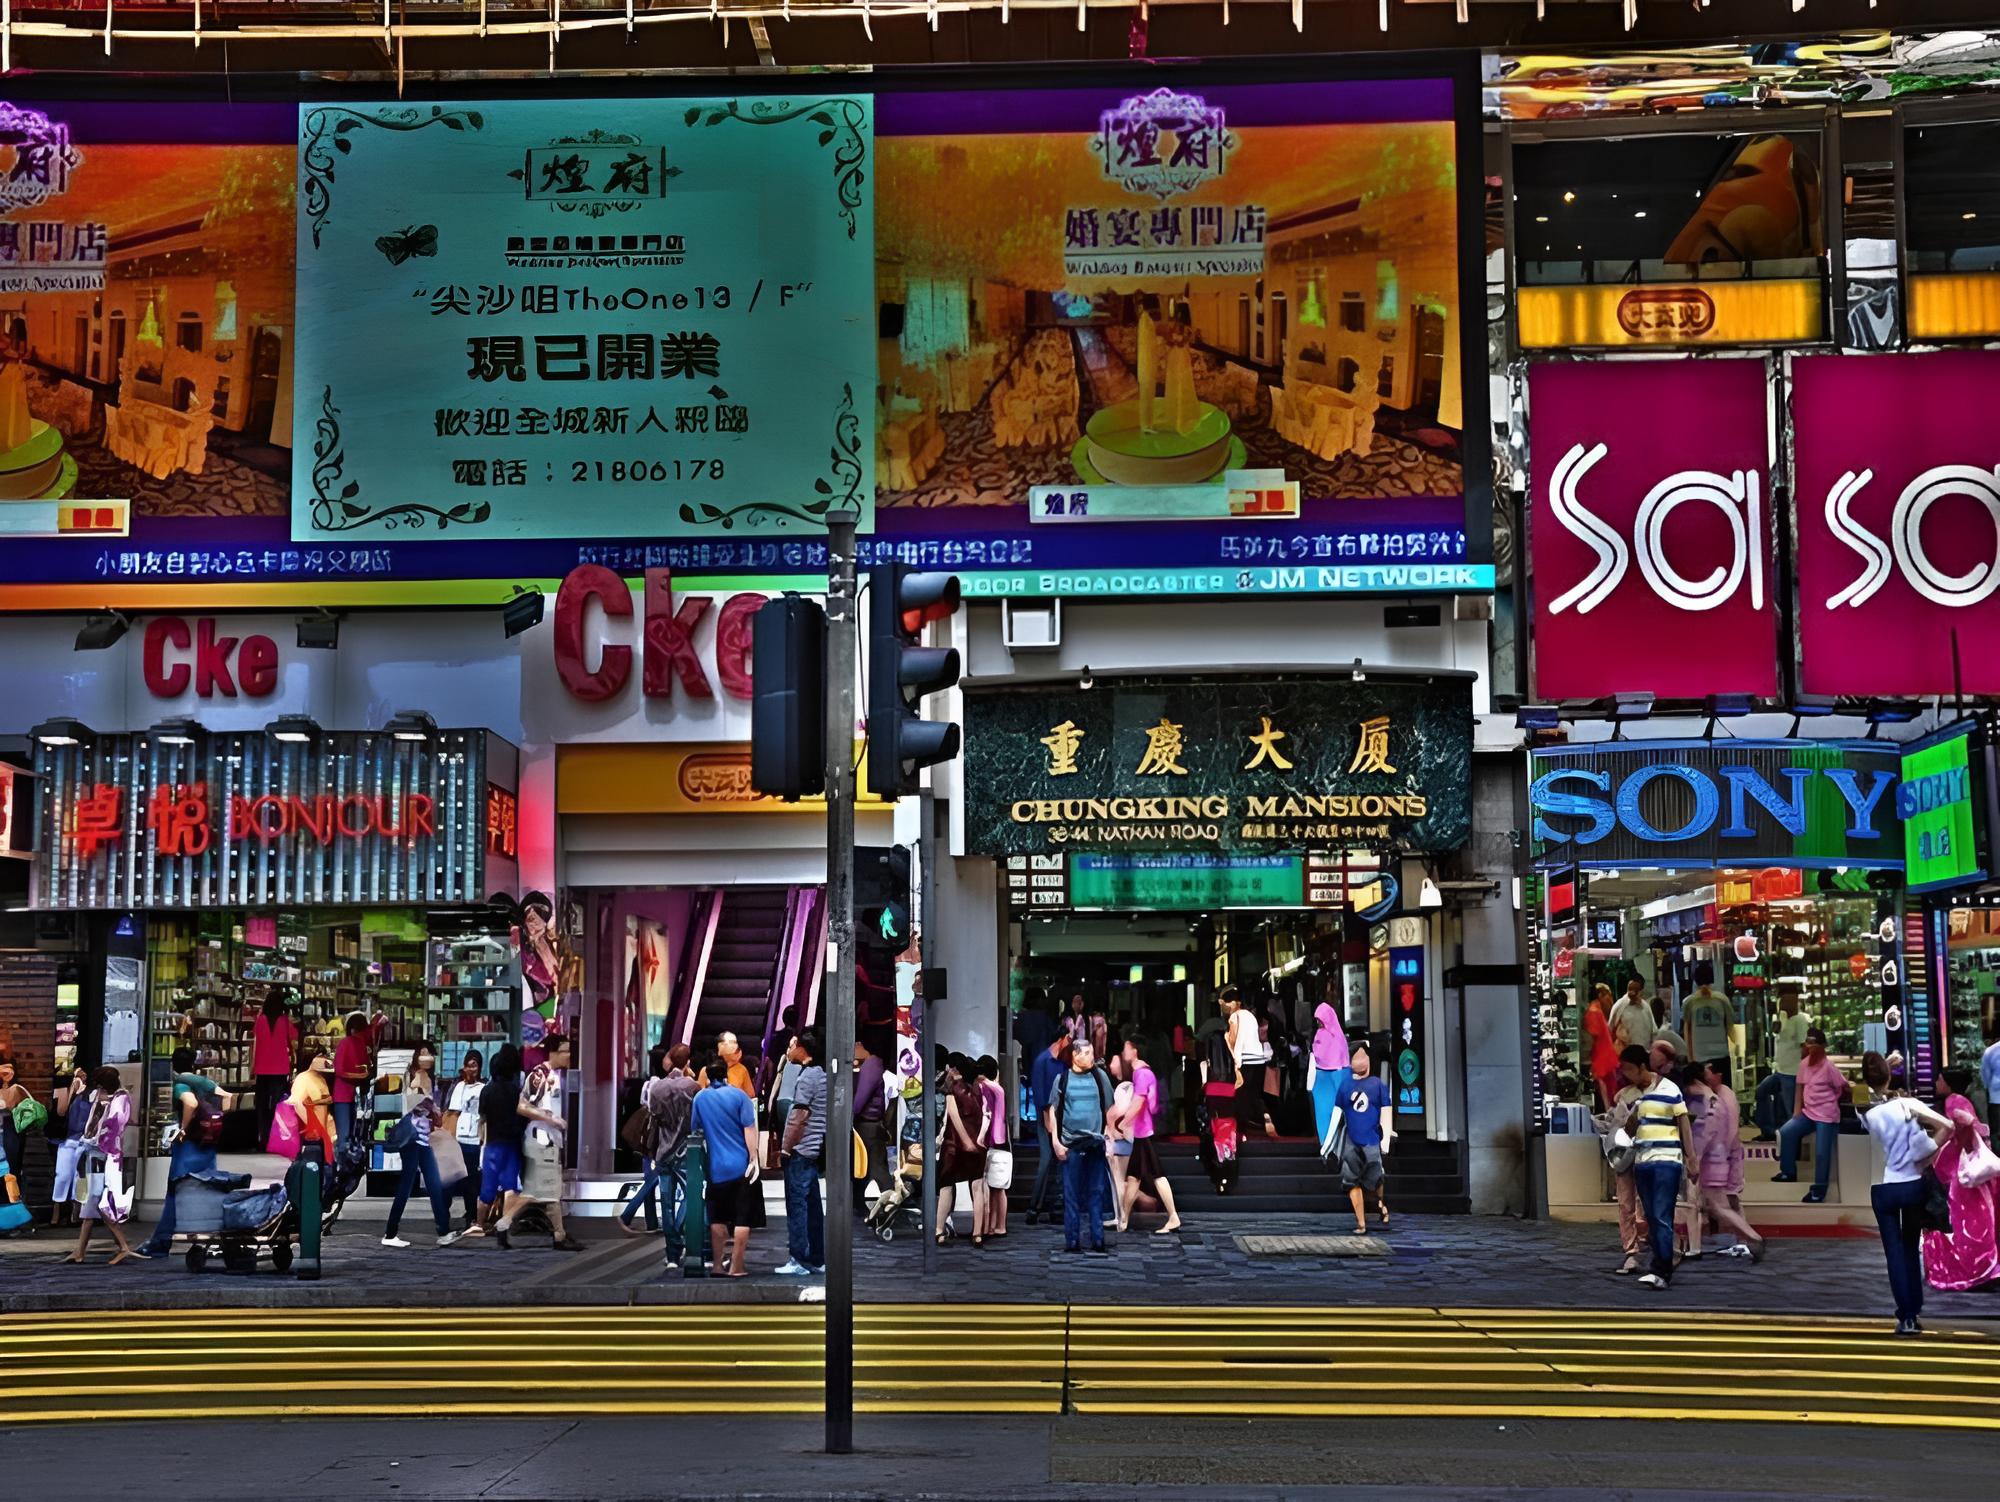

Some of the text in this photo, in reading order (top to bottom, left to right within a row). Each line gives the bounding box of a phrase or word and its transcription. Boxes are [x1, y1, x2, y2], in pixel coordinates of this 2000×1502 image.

[466, 331, 721, 382] 現已開業
[571, 458, 725, 482] 21806178
[229, 794, 433, 846] BONJOUR
[1011, 795, 1427, 823] CHUNGKING MANSIONS
[1530, 763, 1896, 845] SONY
